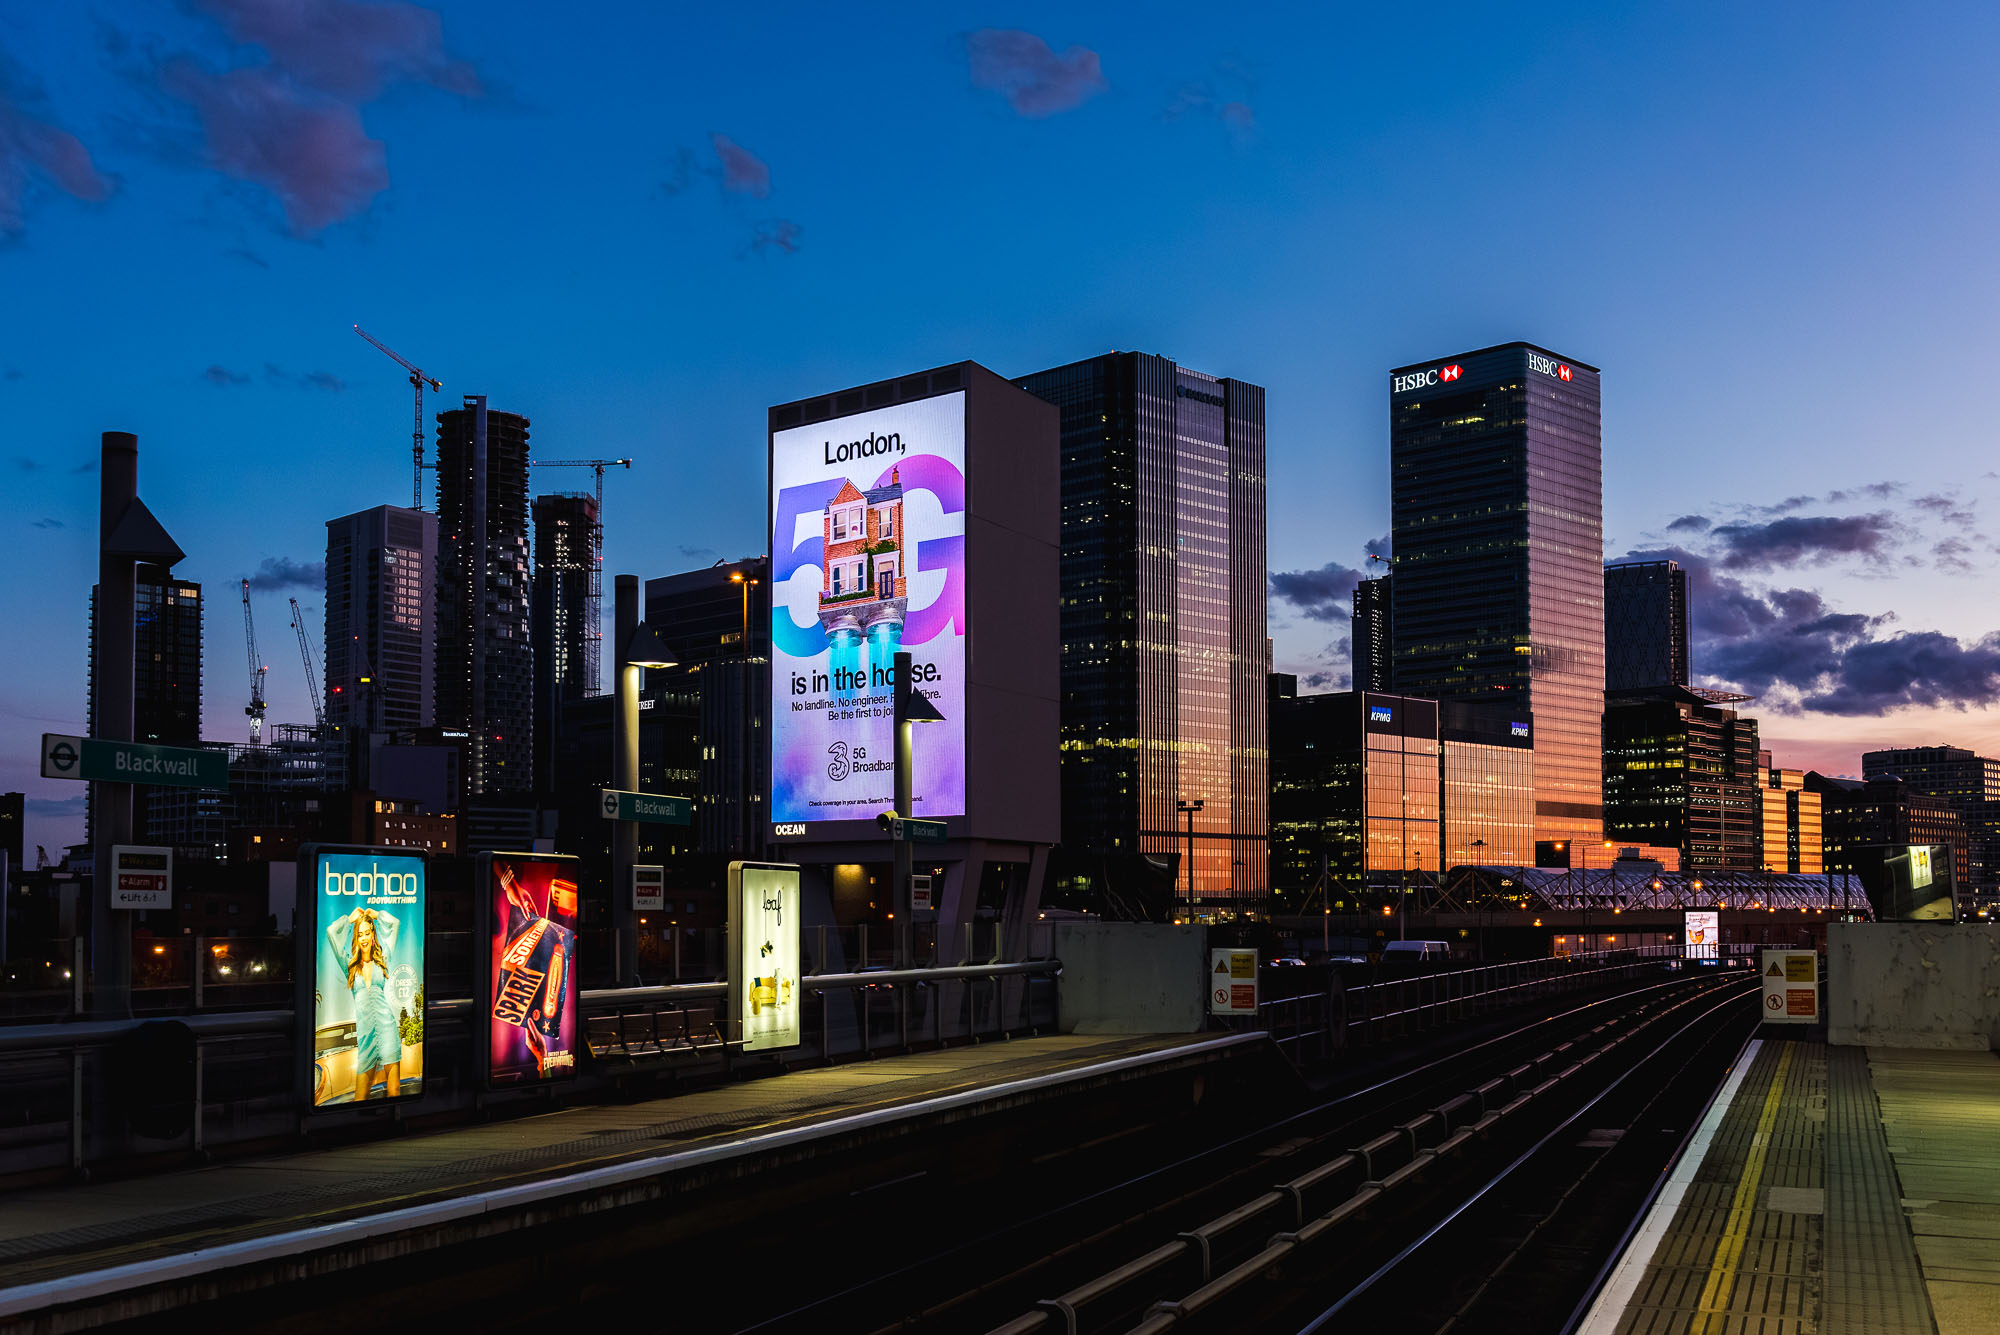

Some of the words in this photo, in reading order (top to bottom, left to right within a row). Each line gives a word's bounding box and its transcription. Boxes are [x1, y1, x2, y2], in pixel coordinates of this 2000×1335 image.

[1528, 352, 1557, 378] HSBC
[1394, 368, 1438, 393] HSBC
[825, 431, 906, 466] London,
[791, 671, 807, 695] is
[812, 669, 829, 694] in
[834, 665, 867, 691] the
[872, 662, 942, 688] hose.
[791, 701, 803, 712] No
[804, 699, 837, 711] landline.
[838, 697, 850, 708] No
[851, 694, 888, 708] engineer.
[828, 711, 839, 721] Be
[841, 709, 854, 720] the
[855, 707, 872, 719] first
[873, 707, 882, 717] to
[1370, 711, 1391, 723] KPMG
[1511, 727, 1528, 737] KPMG
[853, 747, 867, 759] 5G
[115, 751, 198, 777] Blackwall
[635, 799, 676, 817] Blackwall
[775, 823, 806, 836] OCEAN
[128, 877, 151, 886] Alarm
[325, 861, 417, 896] boohoo
[127, 893, 141, 902] Lift
[366, 896, 417, 905] #DOYOURTHING
[762, 889, 782, 927] loaf
[494, 966, 543, 1024] SPARK
